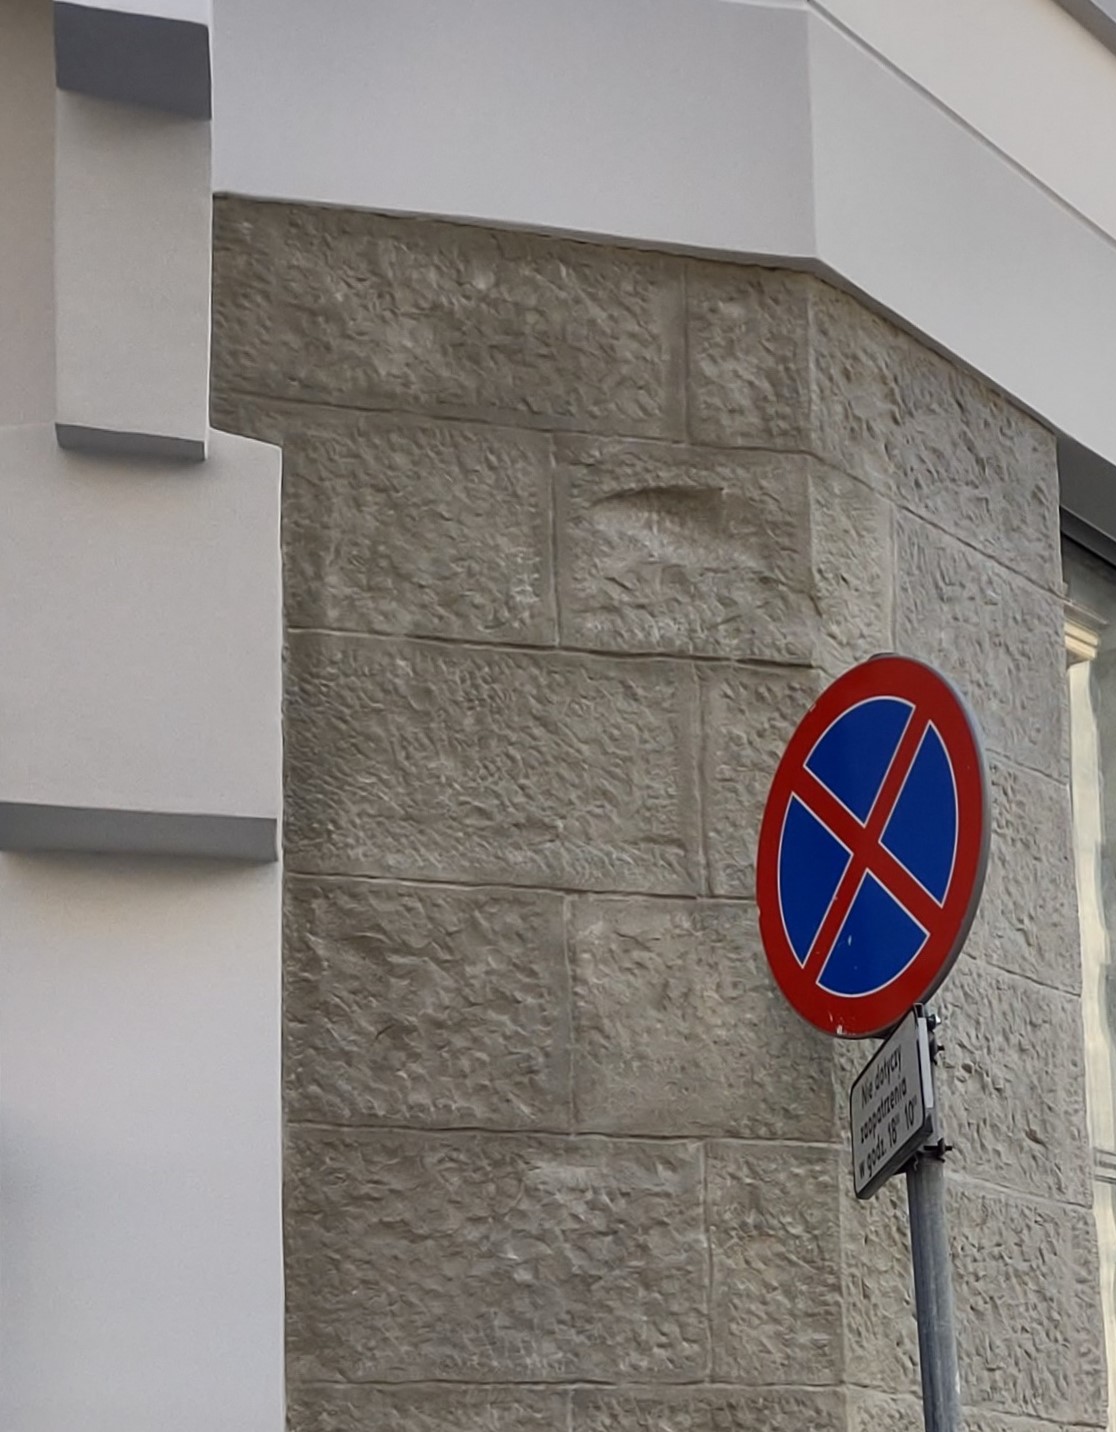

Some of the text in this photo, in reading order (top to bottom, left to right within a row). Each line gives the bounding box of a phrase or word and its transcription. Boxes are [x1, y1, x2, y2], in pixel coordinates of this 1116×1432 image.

[861, 1044, 902, 1109] Nie dotyczy
[860, 1077, 907, 1145] zaopatrzenia
